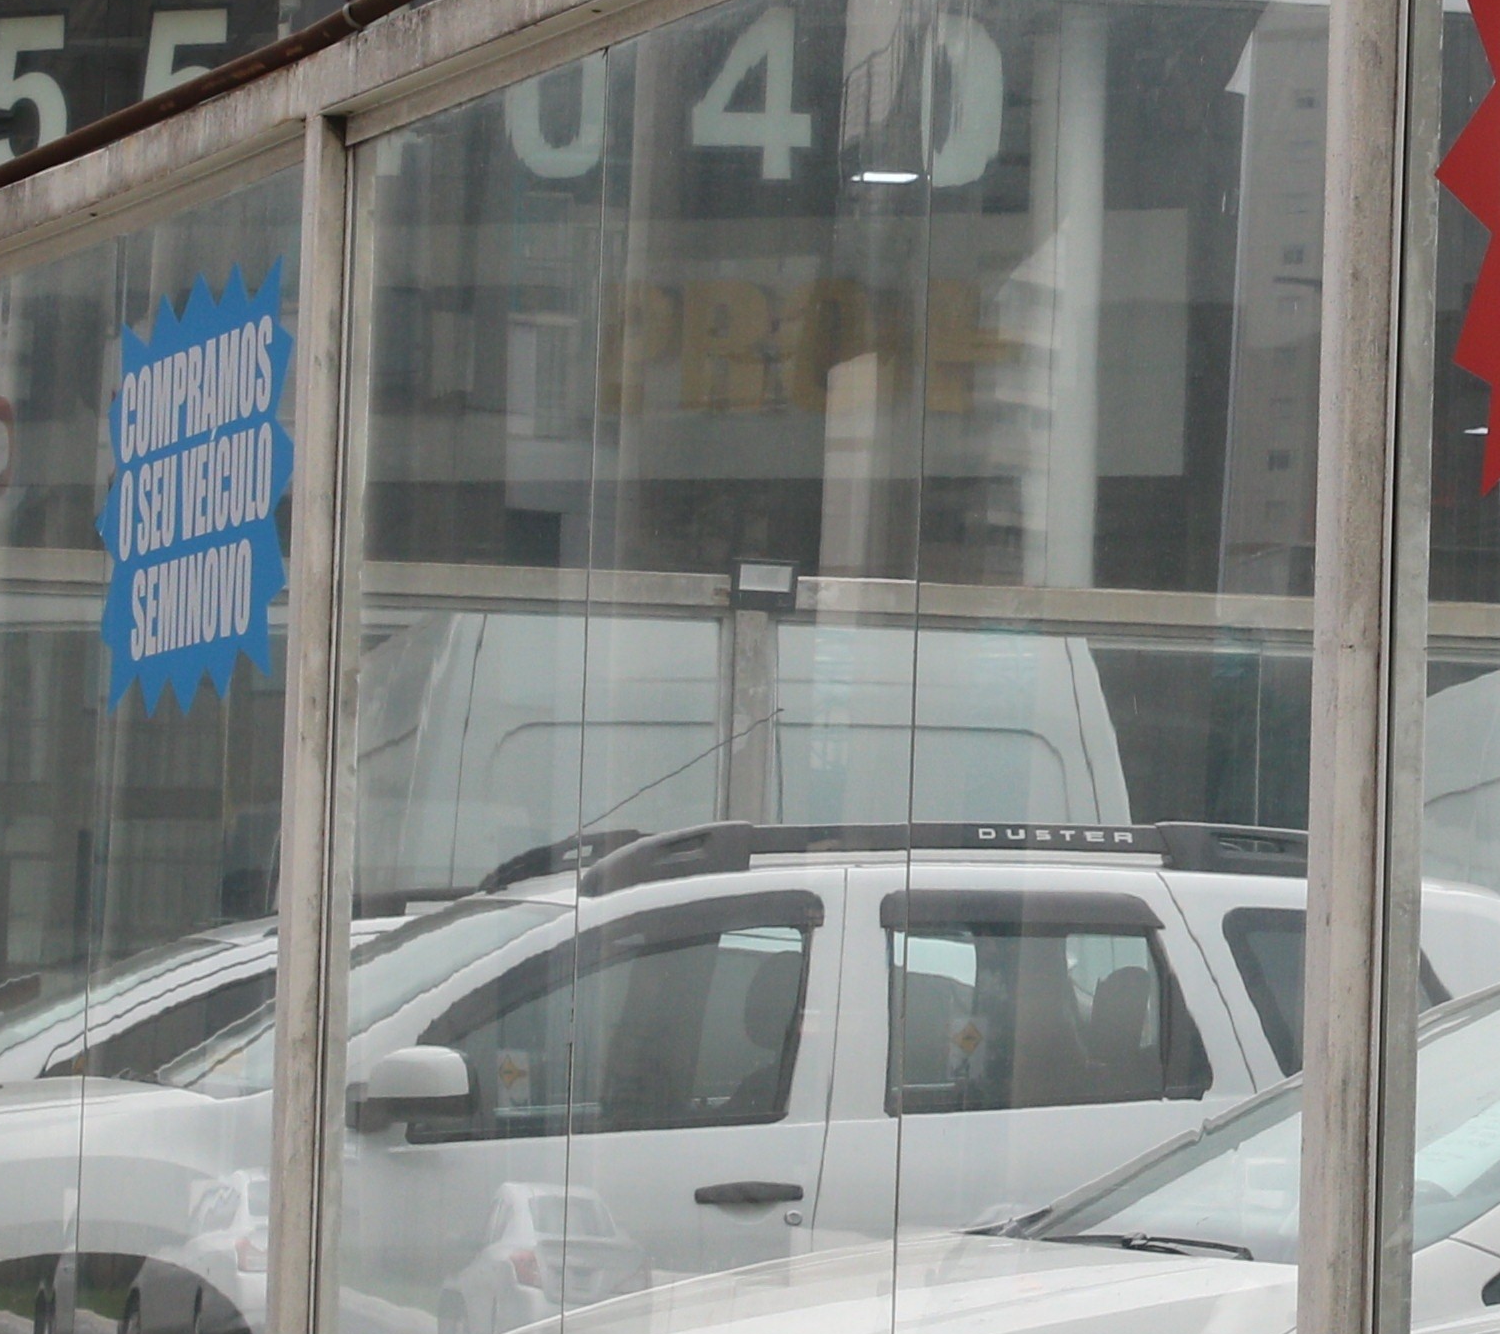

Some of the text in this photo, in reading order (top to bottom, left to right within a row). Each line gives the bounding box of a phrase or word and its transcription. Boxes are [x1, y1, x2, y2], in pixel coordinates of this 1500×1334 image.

[119, 315, 273, 464] COMPRAMOS
[118, 422, 273, 562] O SEU VEÍCULO
[130, 538, 253, 661] SEMINOVO
[977, 825, 1135, 844] DUSTER
